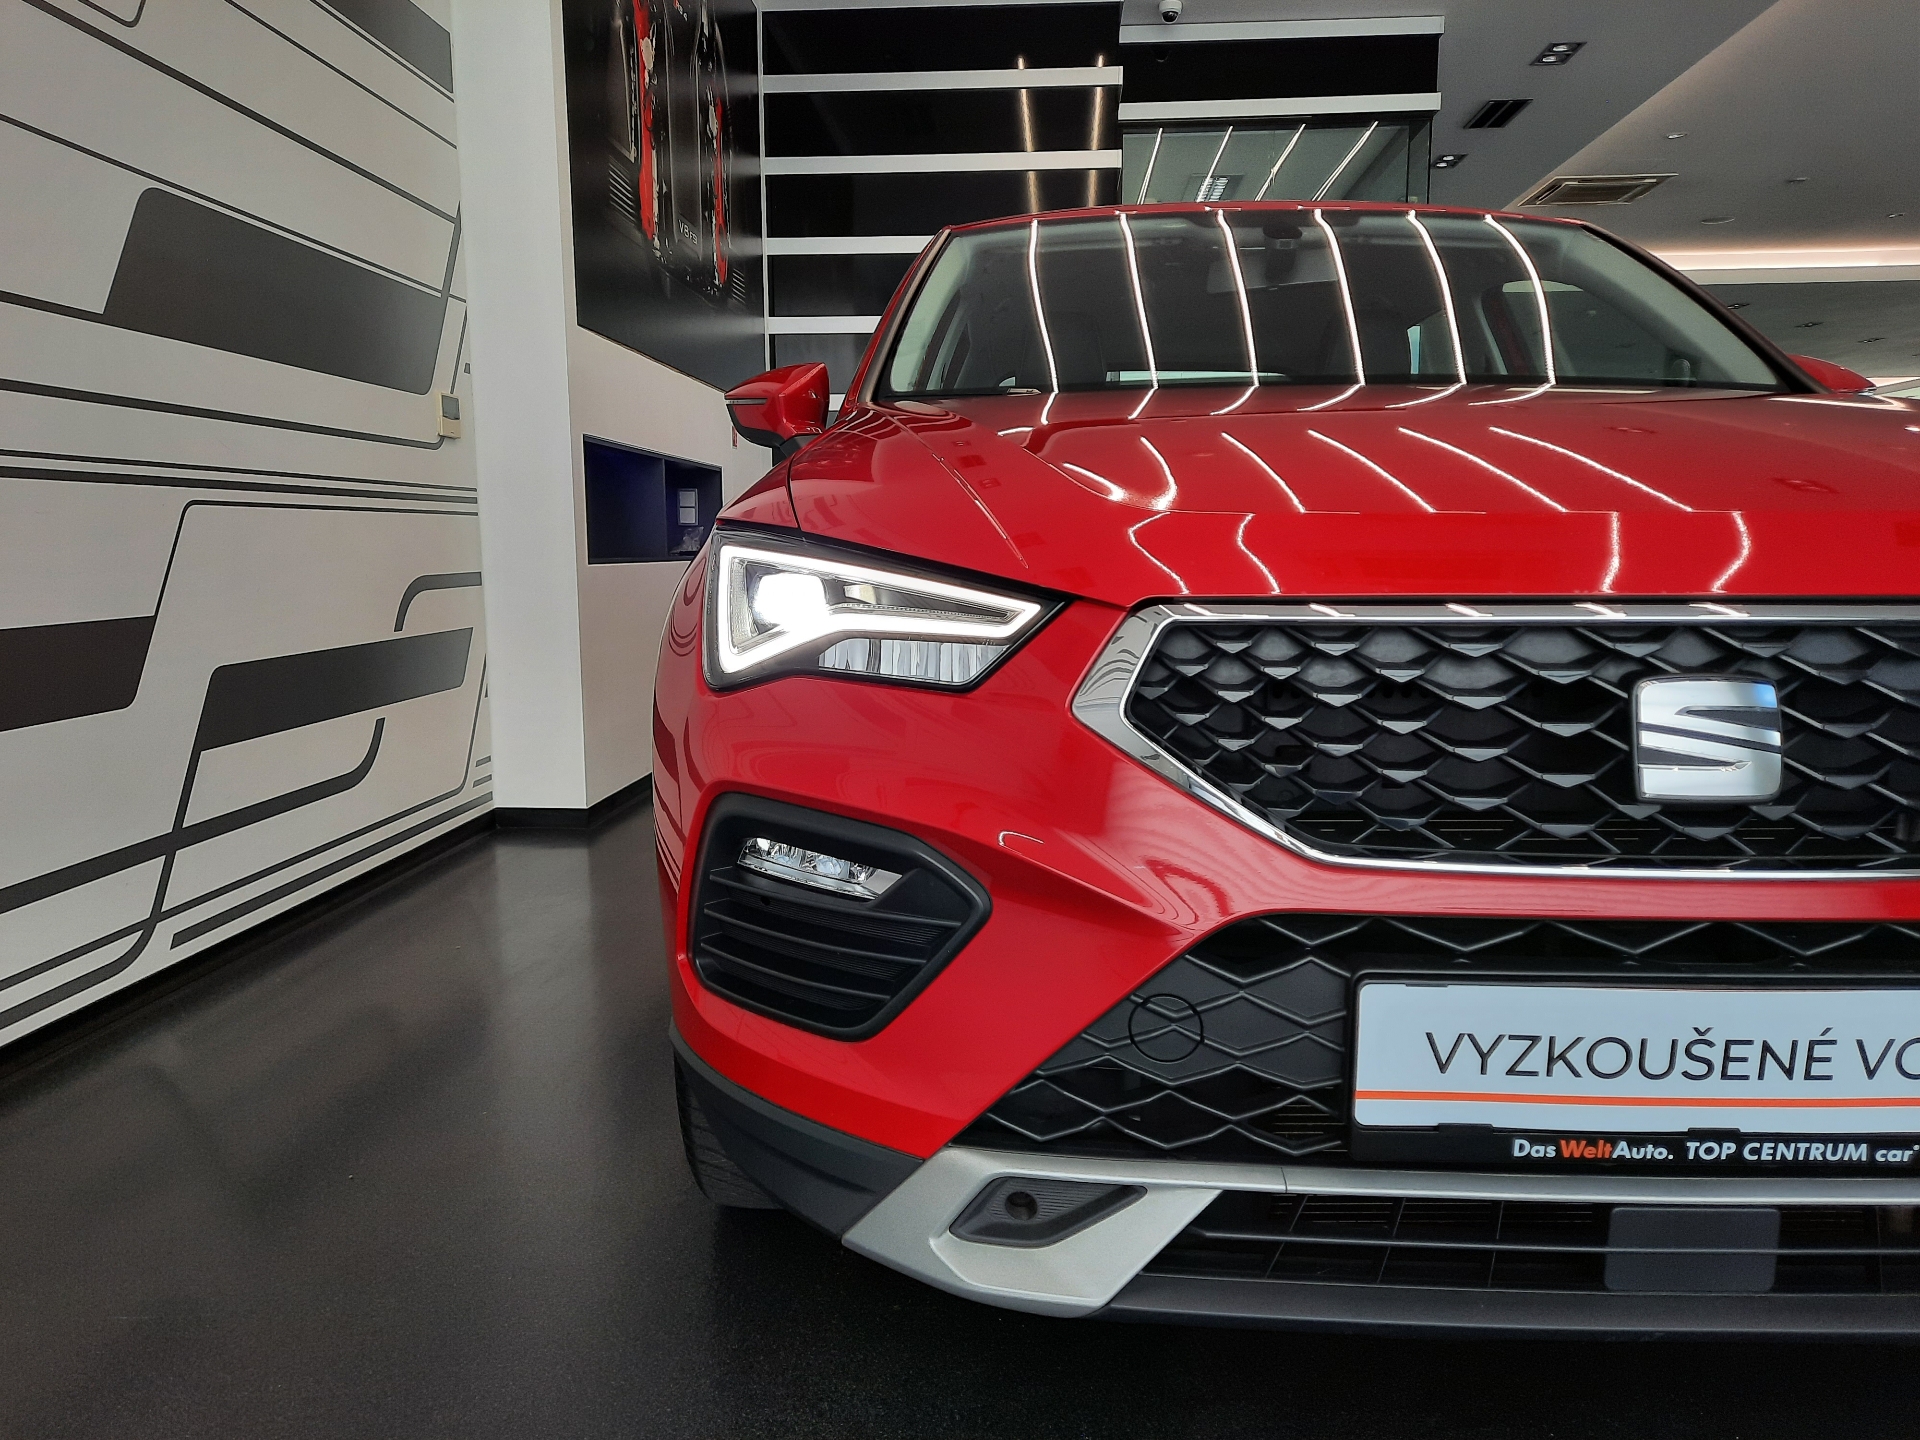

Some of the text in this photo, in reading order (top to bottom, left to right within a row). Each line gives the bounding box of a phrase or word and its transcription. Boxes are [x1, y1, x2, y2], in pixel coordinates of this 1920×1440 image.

[1426, 1027, 1838, 1081] VYZKOUŠENÉ
[1513, 1139, 1557, 1158] Das
[1560, 1139, 1674, 1160] WeltAuto.
[1686, 1141, 1737, 1161] TOP
[1743, 1142, 1868, 1161] CENTRUM
